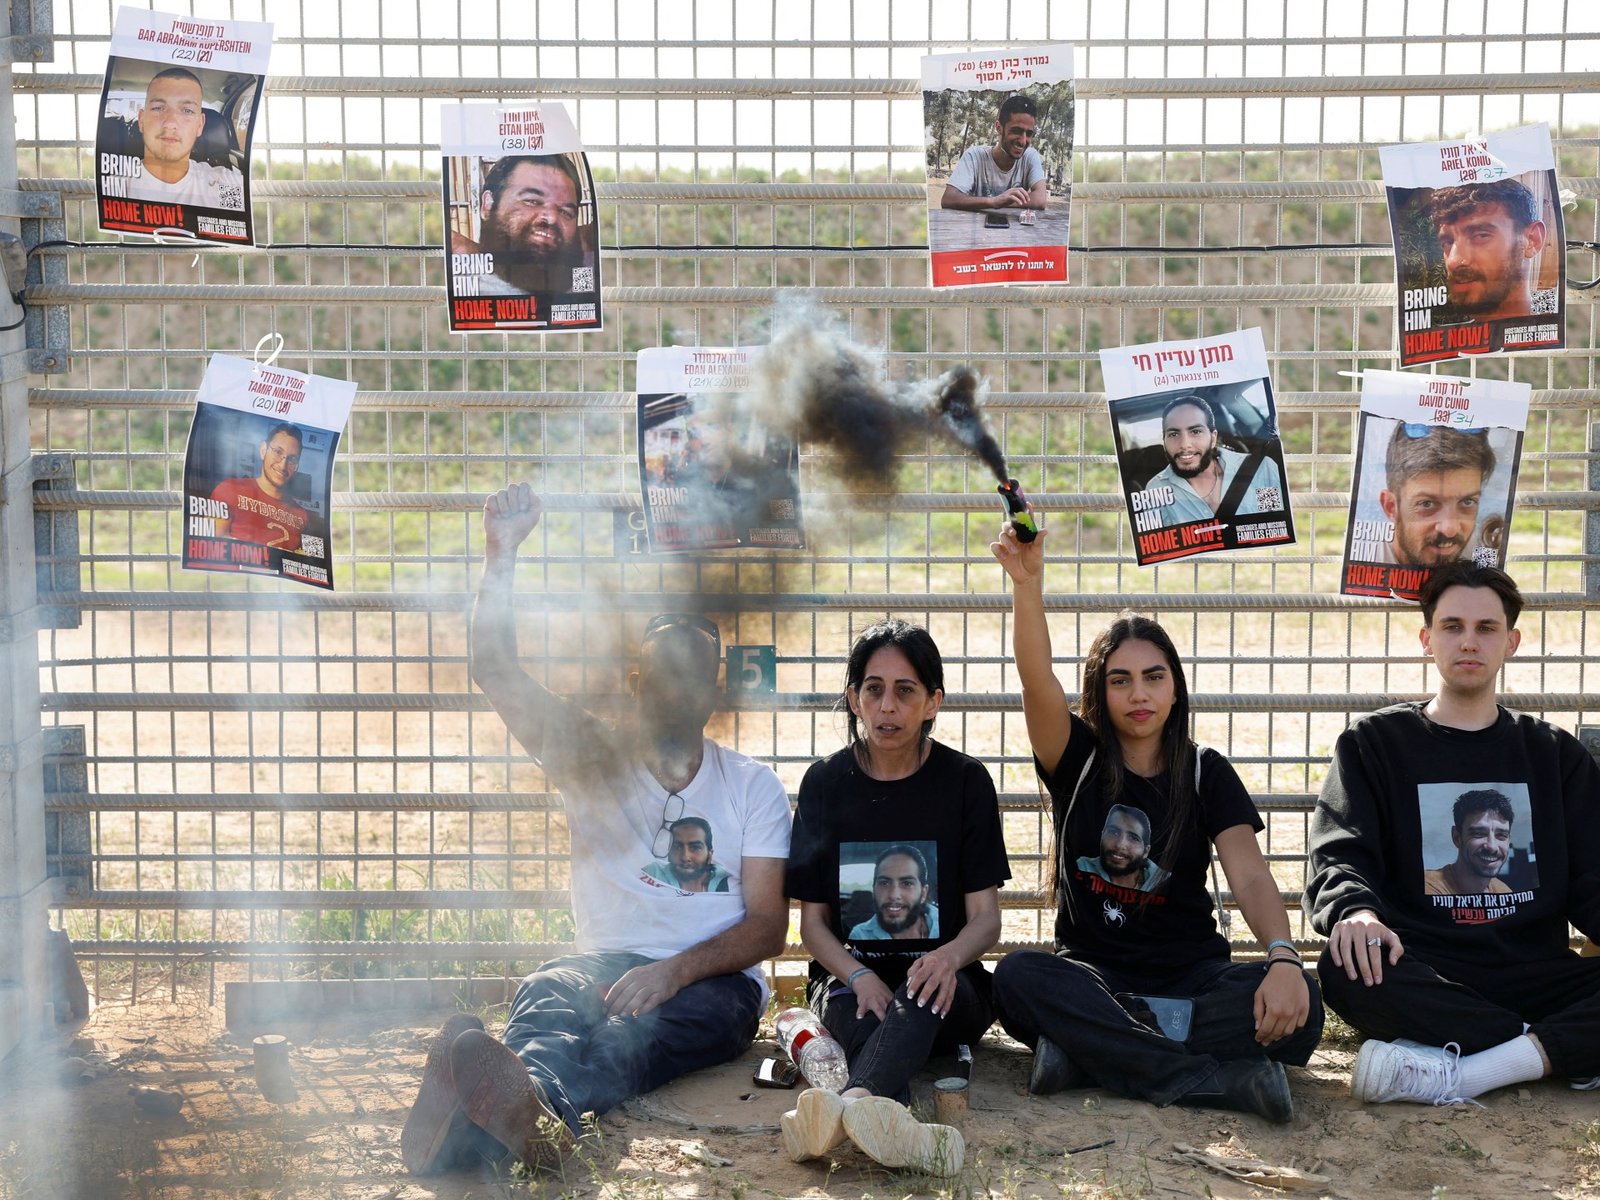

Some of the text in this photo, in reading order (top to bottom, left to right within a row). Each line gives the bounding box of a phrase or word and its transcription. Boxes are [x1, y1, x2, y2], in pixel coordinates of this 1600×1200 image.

[138, 28, 156, 41] BAR
[216, 26, 224, 38] בר
[172, 48, 195, 60] (22)
[1023, 56, 1049, 66] נמרוד
[1001, 58, 1019, 70] כהן
[976, 71, 1003, 84] חטוף
[500, 122, 544, 135] EITAN HORN
[502, 138, 525, 150] (38)
[101, 152, 142, 178] BRING
[1441, 158, 1465, 171] ARIEL
[1484, 168, 1507, 178] 27
[101, 175, 128, 198] HIM
[103, 199, 184, 227] HOME NOW!
[198, 222, 247, 237] FAMILIES FORUM
[452, 253, 494, 275] BRING
[953, 264, 977, 273] בשבי
[980, 260, 1014, 271] להשאר
[1045, 260, 1054, 269] אל
[453, 275, 480, 296] HIM
[1404, 286, 1447, 310] BRING
[454, 296, 537, 320] HOME NOW!
[551, 310, 596, 322] FAMILIES FORUM
[1404, 311, 1431, 332] HIM
[1405, 322, 1490, 355] HOME NOW!
[1504, 330, 1558, 344] FAMILIES FORUM
[1132, 344, 1234, 372] מתן עדיין חי
[684, 365, 705, 375] EDAN
[1154, 371, 1219, 387] מתן צנגאוקר (24)
[248, 380, 306, 403] TAMIR NIMRODI
[252, 396, 274, 411] (20)
[1419, 395, 1469, 410] DAVID CUNIO
[1453, 413, 1474, 427] 34
[648, 486, 689, 506] BRING
[1131, 486, 1175, 512] BRING
[189, 495, 229, 519] BRING
[651, 506, 678, 523] HIM
[189, 516, 215, 537] HIM
[1134, 509, 1164, 533] HIM
[267, 522, 289, 546] 2
[1139, 519, 1223, 556] HOME NOW!
[1237, 528, 1288, 541] FAMILIES FORUM
[1353, 520, 1395, 543] BRING
[188, 539, 270, 566] HOME NOW!
[1350, 541, 1378, 562] HIM
[283, 564, 328, 582] FAMILIES FORUM
[1347, 564, 1384, 587] HOME
[742, 649, 762, 689] 5
[1432, 891, 1534, 908] מחזירים את אריאל קוניו
[1452, 906, 1516, 919] הביתה עכשיו!
